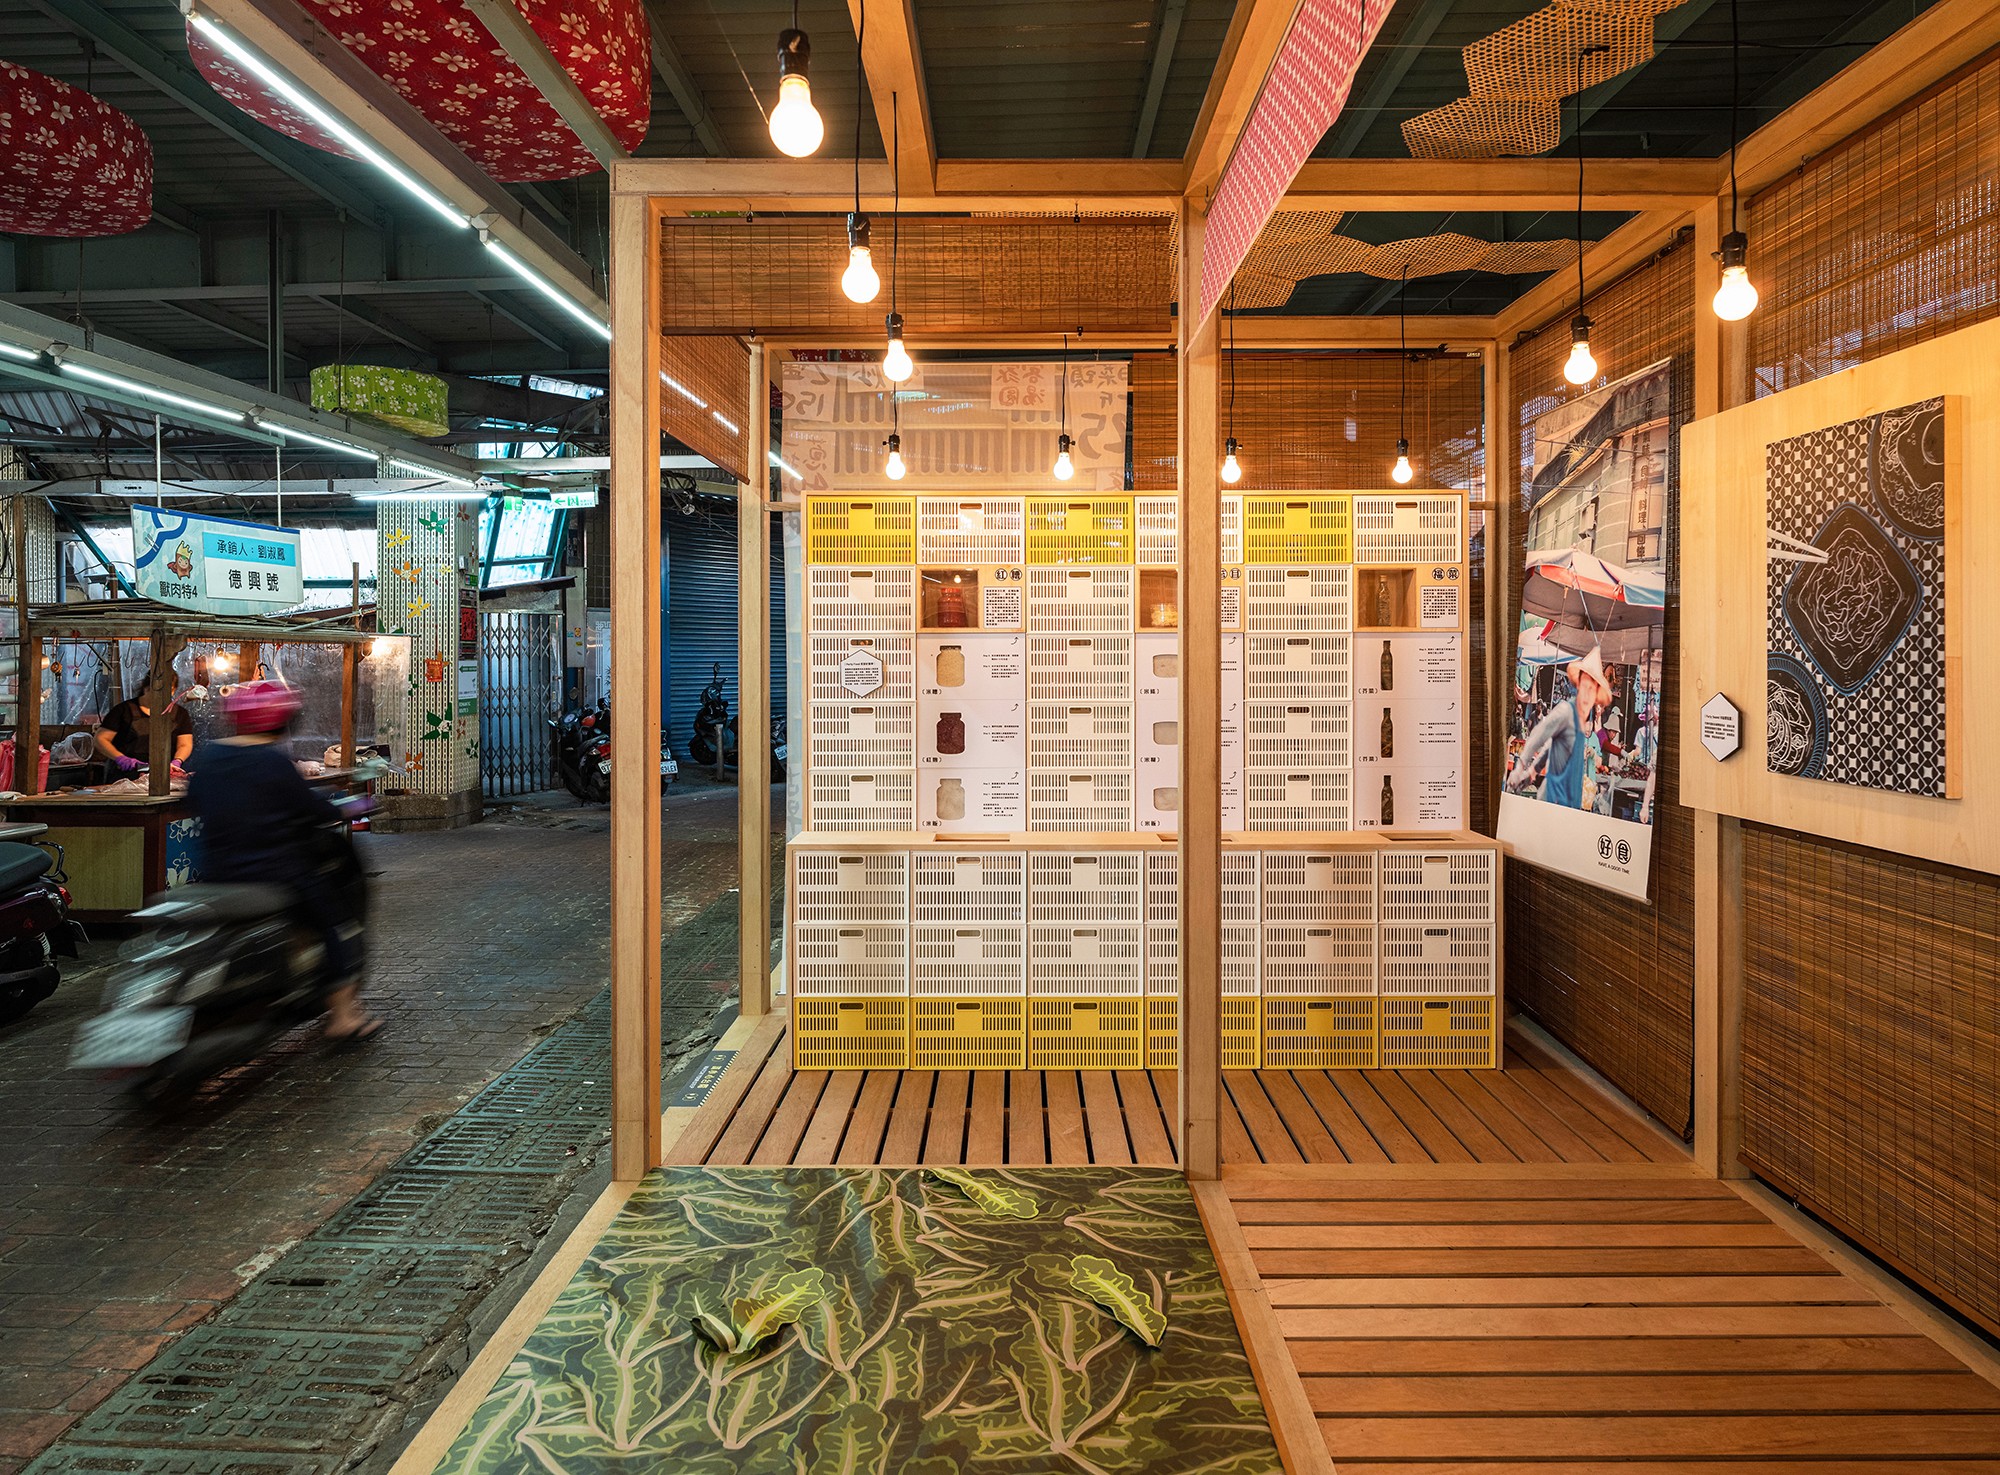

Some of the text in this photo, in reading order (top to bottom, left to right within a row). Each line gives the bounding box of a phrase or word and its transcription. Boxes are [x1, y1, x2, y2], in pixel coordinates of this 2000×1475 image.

[159, 580, 198, 600] 獸肉特4
[228, 569, 280, 592] 德興號
[1599, 837, 1630, 863] 好食
